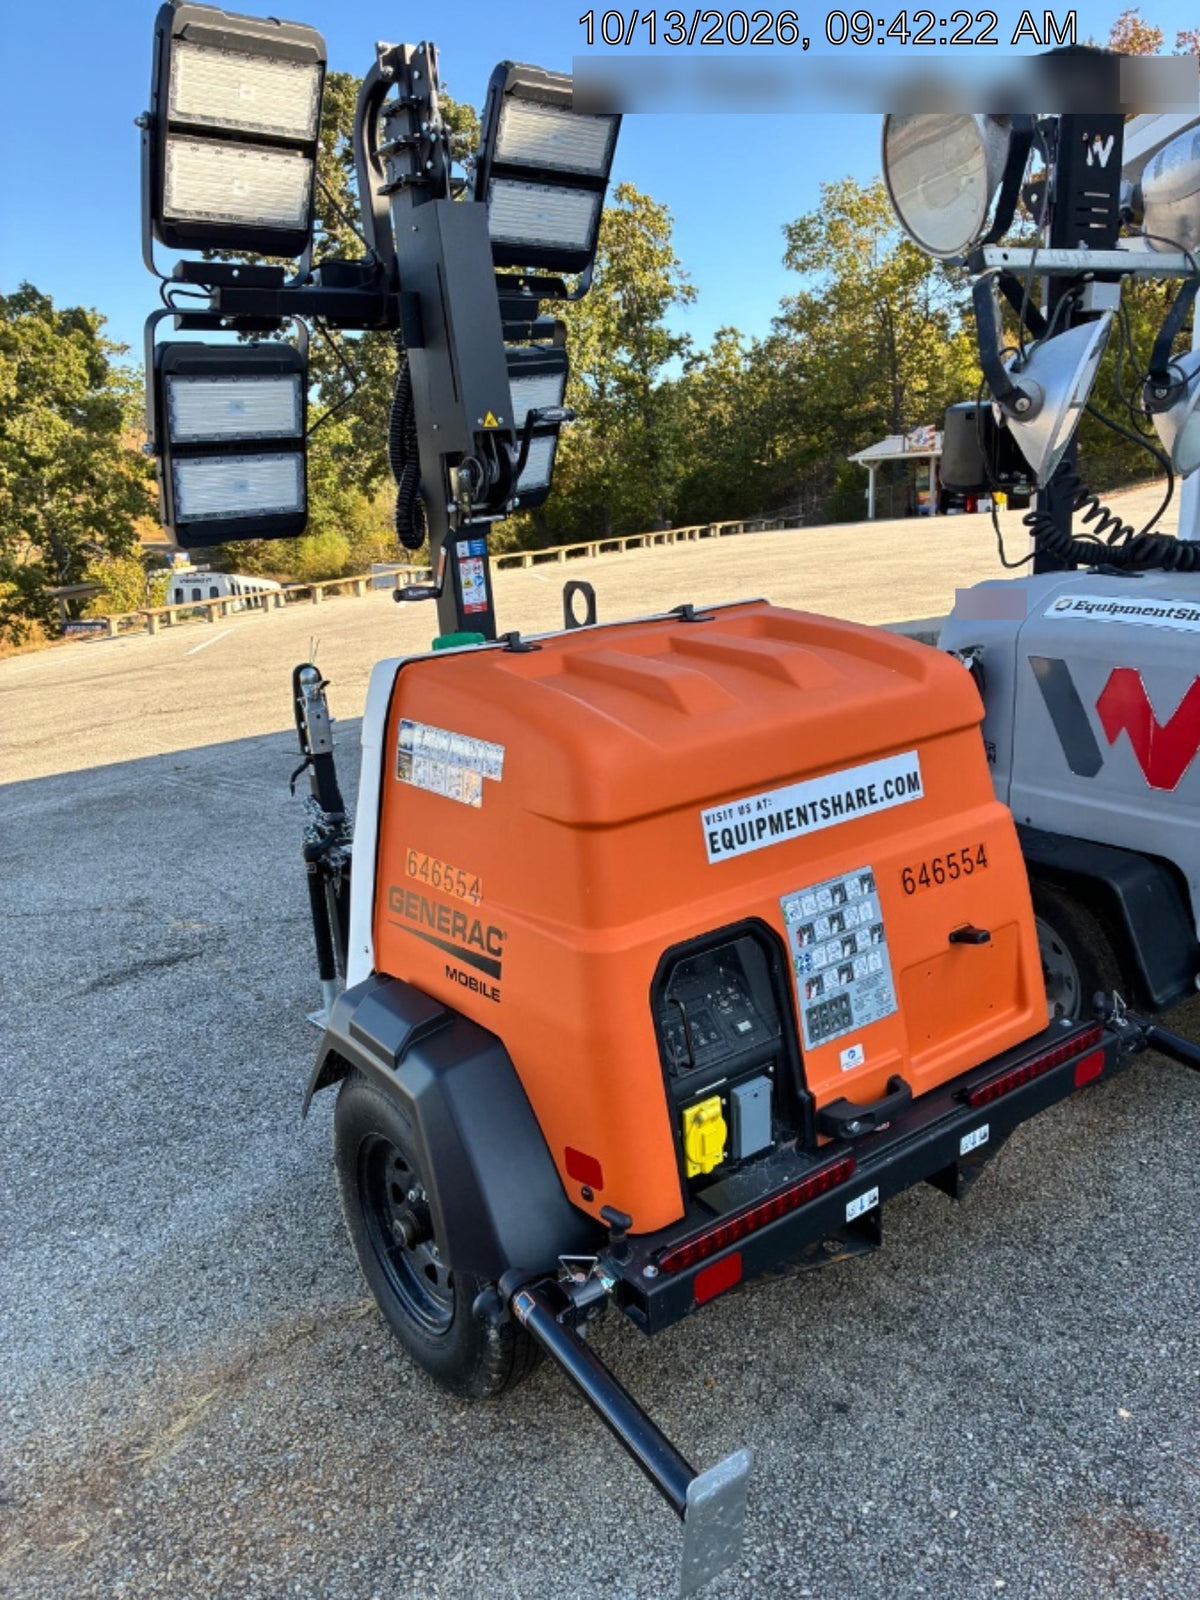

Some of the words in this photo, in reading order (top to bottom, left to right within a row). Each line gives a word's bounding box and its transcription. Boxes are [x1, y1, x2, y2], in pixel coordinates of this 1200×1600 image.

[704, 807, 734, 826] VISIT
[738, 804, 752, 816] US
[708, 771, 921, 854] EQUIPMENTSHARE.COM
[407, 850, 481, 905] 646554
[902, 844, 988, 895] 646554
[388, 885, 503, 958] GENERAC
[445, 965, 502, 1004] MOBILE
